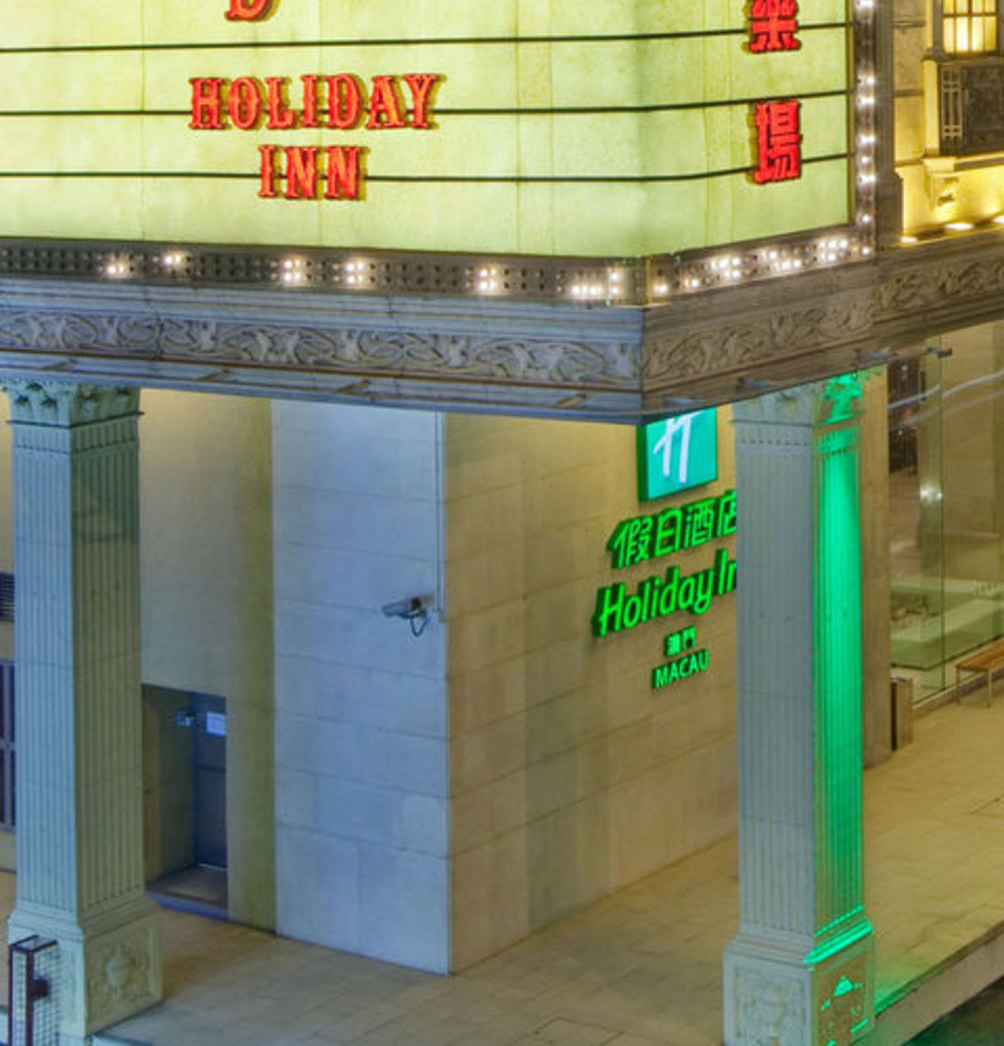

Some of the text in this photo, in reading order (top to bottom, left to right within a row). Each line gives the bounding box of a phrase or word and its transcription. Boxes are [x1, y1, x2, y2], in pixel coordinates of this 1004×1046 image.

[188, 72, 438, 130] HOLIDAY
[258, 144, 362, 200] INN
[597, 565, 714, 638] Holiday
[655, 648, 710, 689] MACAU
